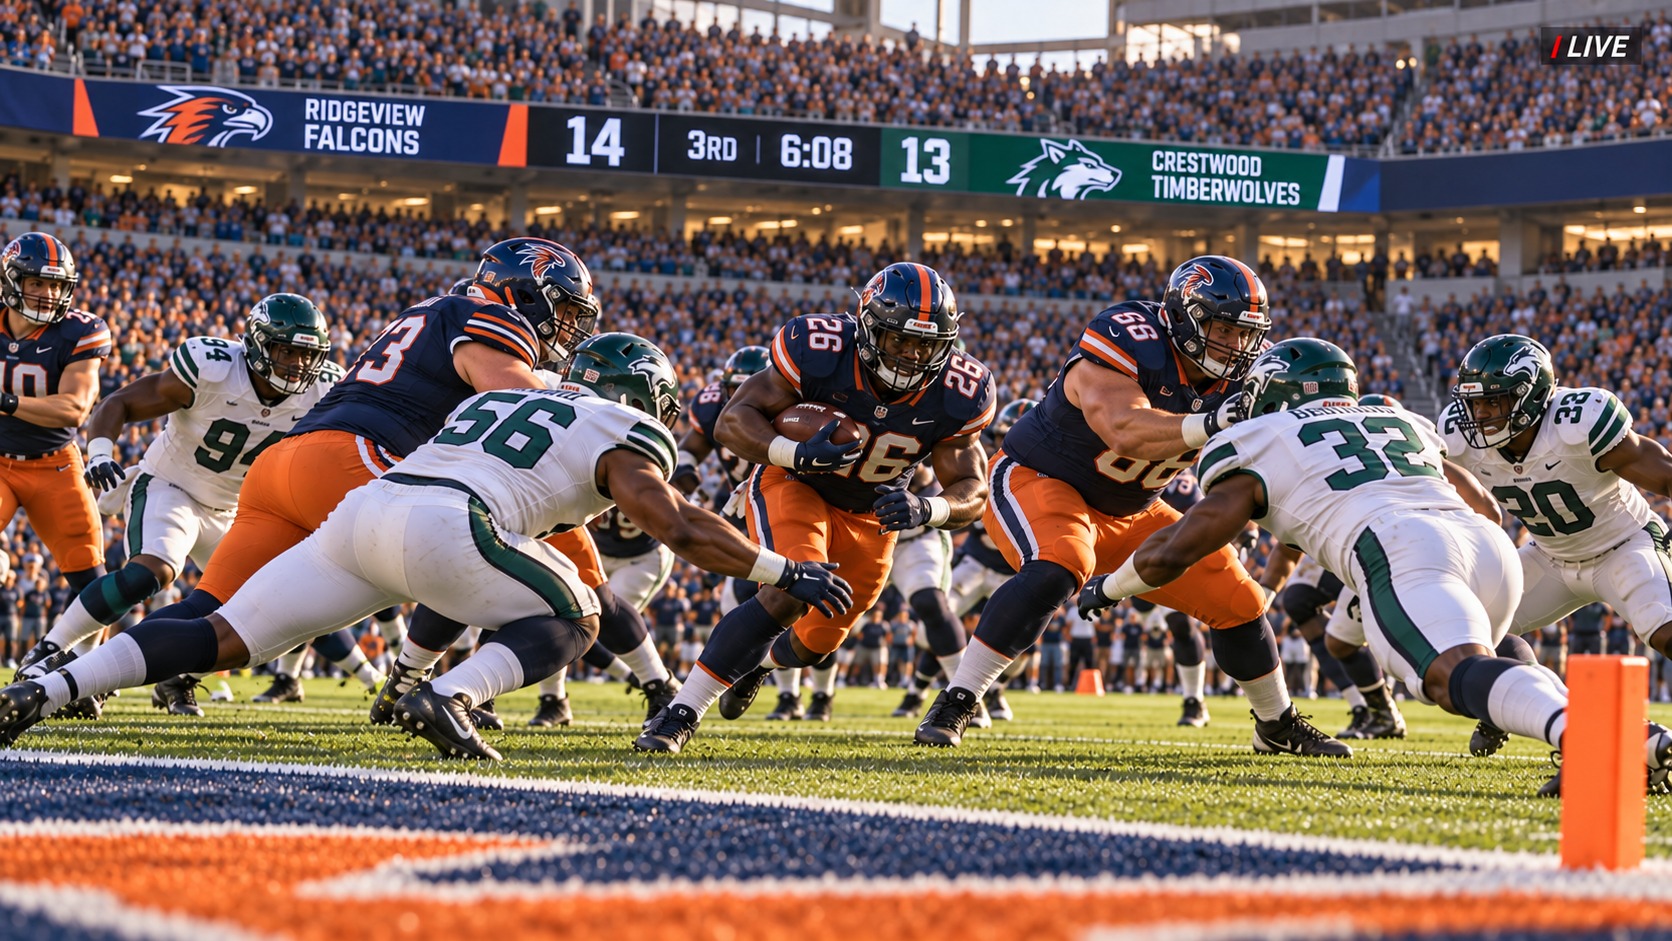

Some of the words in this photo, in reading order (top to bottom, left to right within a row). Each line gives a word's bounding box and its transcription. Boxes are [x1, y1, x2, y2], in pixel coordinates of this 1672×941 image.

[305, 98, 425, 127] RIDGEVIEW
[304, 124, 420, 155] FALCONS
[566, 115, 625, 167] 14
[687, 130, 738, 162] 3RD
[780, 134, 853, 170] 6:08
[900, 136, 951, 184] 13
[1152, 150, 1262, 178] CRESTWOOD
[1151, 175, 1300, 206] TIMBERWOLVES
[200, 337, 233, 363] 94
[806, 317, 844, 353] 26
[943, 354, 984, 400] 26
[1554, 391, 1591, 425] 33
[433, 391, 577, 470] 56
[1297, 416, 1444, 491] 32
[1491, 479, 1596, 537] 20
